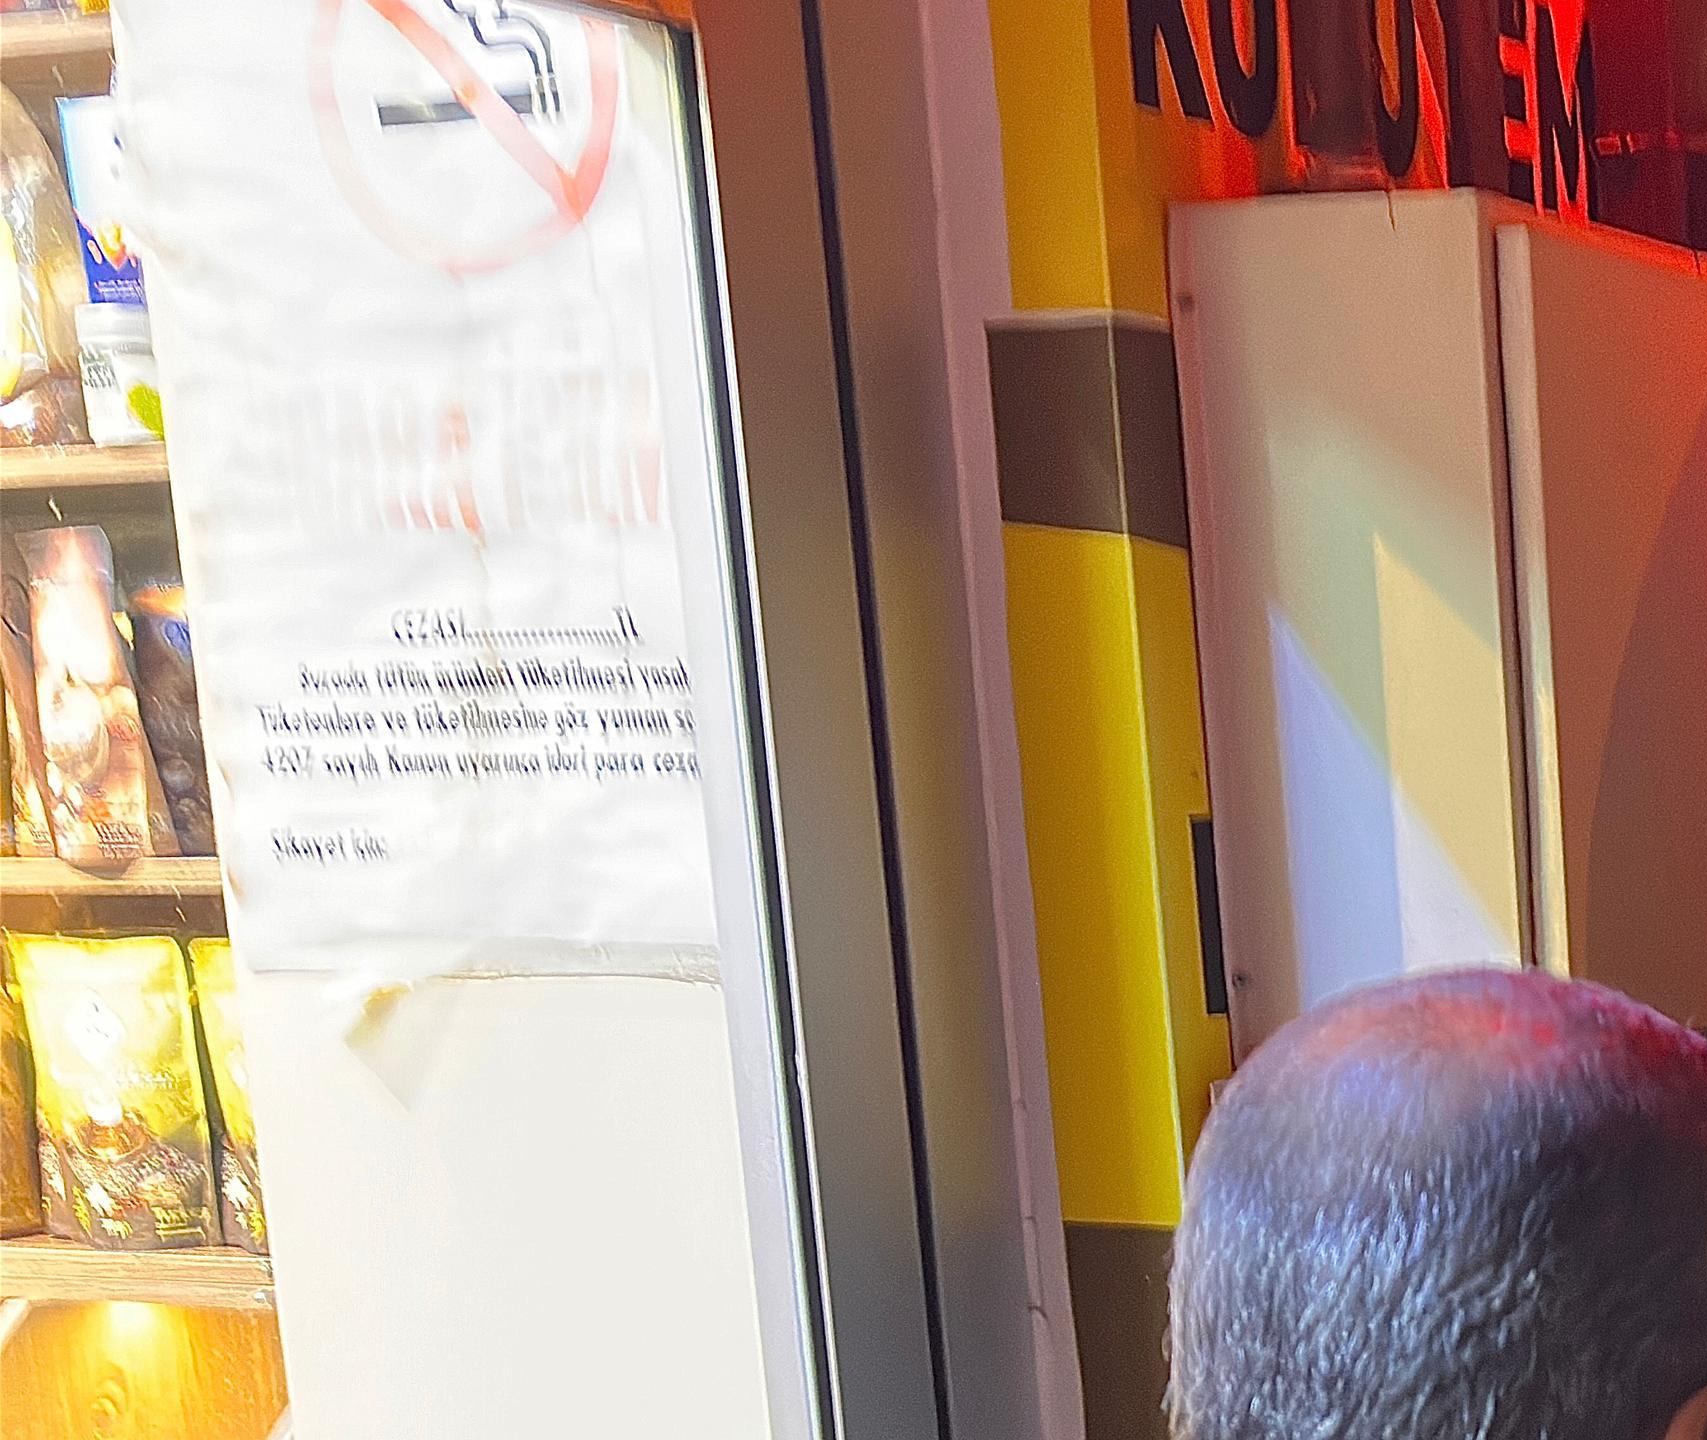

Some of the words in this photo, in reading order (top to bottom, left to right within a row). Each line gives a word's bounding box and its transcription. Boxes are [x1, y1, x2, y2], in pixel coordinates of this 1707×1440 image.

[516, 655, 635, 695] tüketilmesi
[380, 710, 408, 736] ve
[592, 751, 645, 788] para
